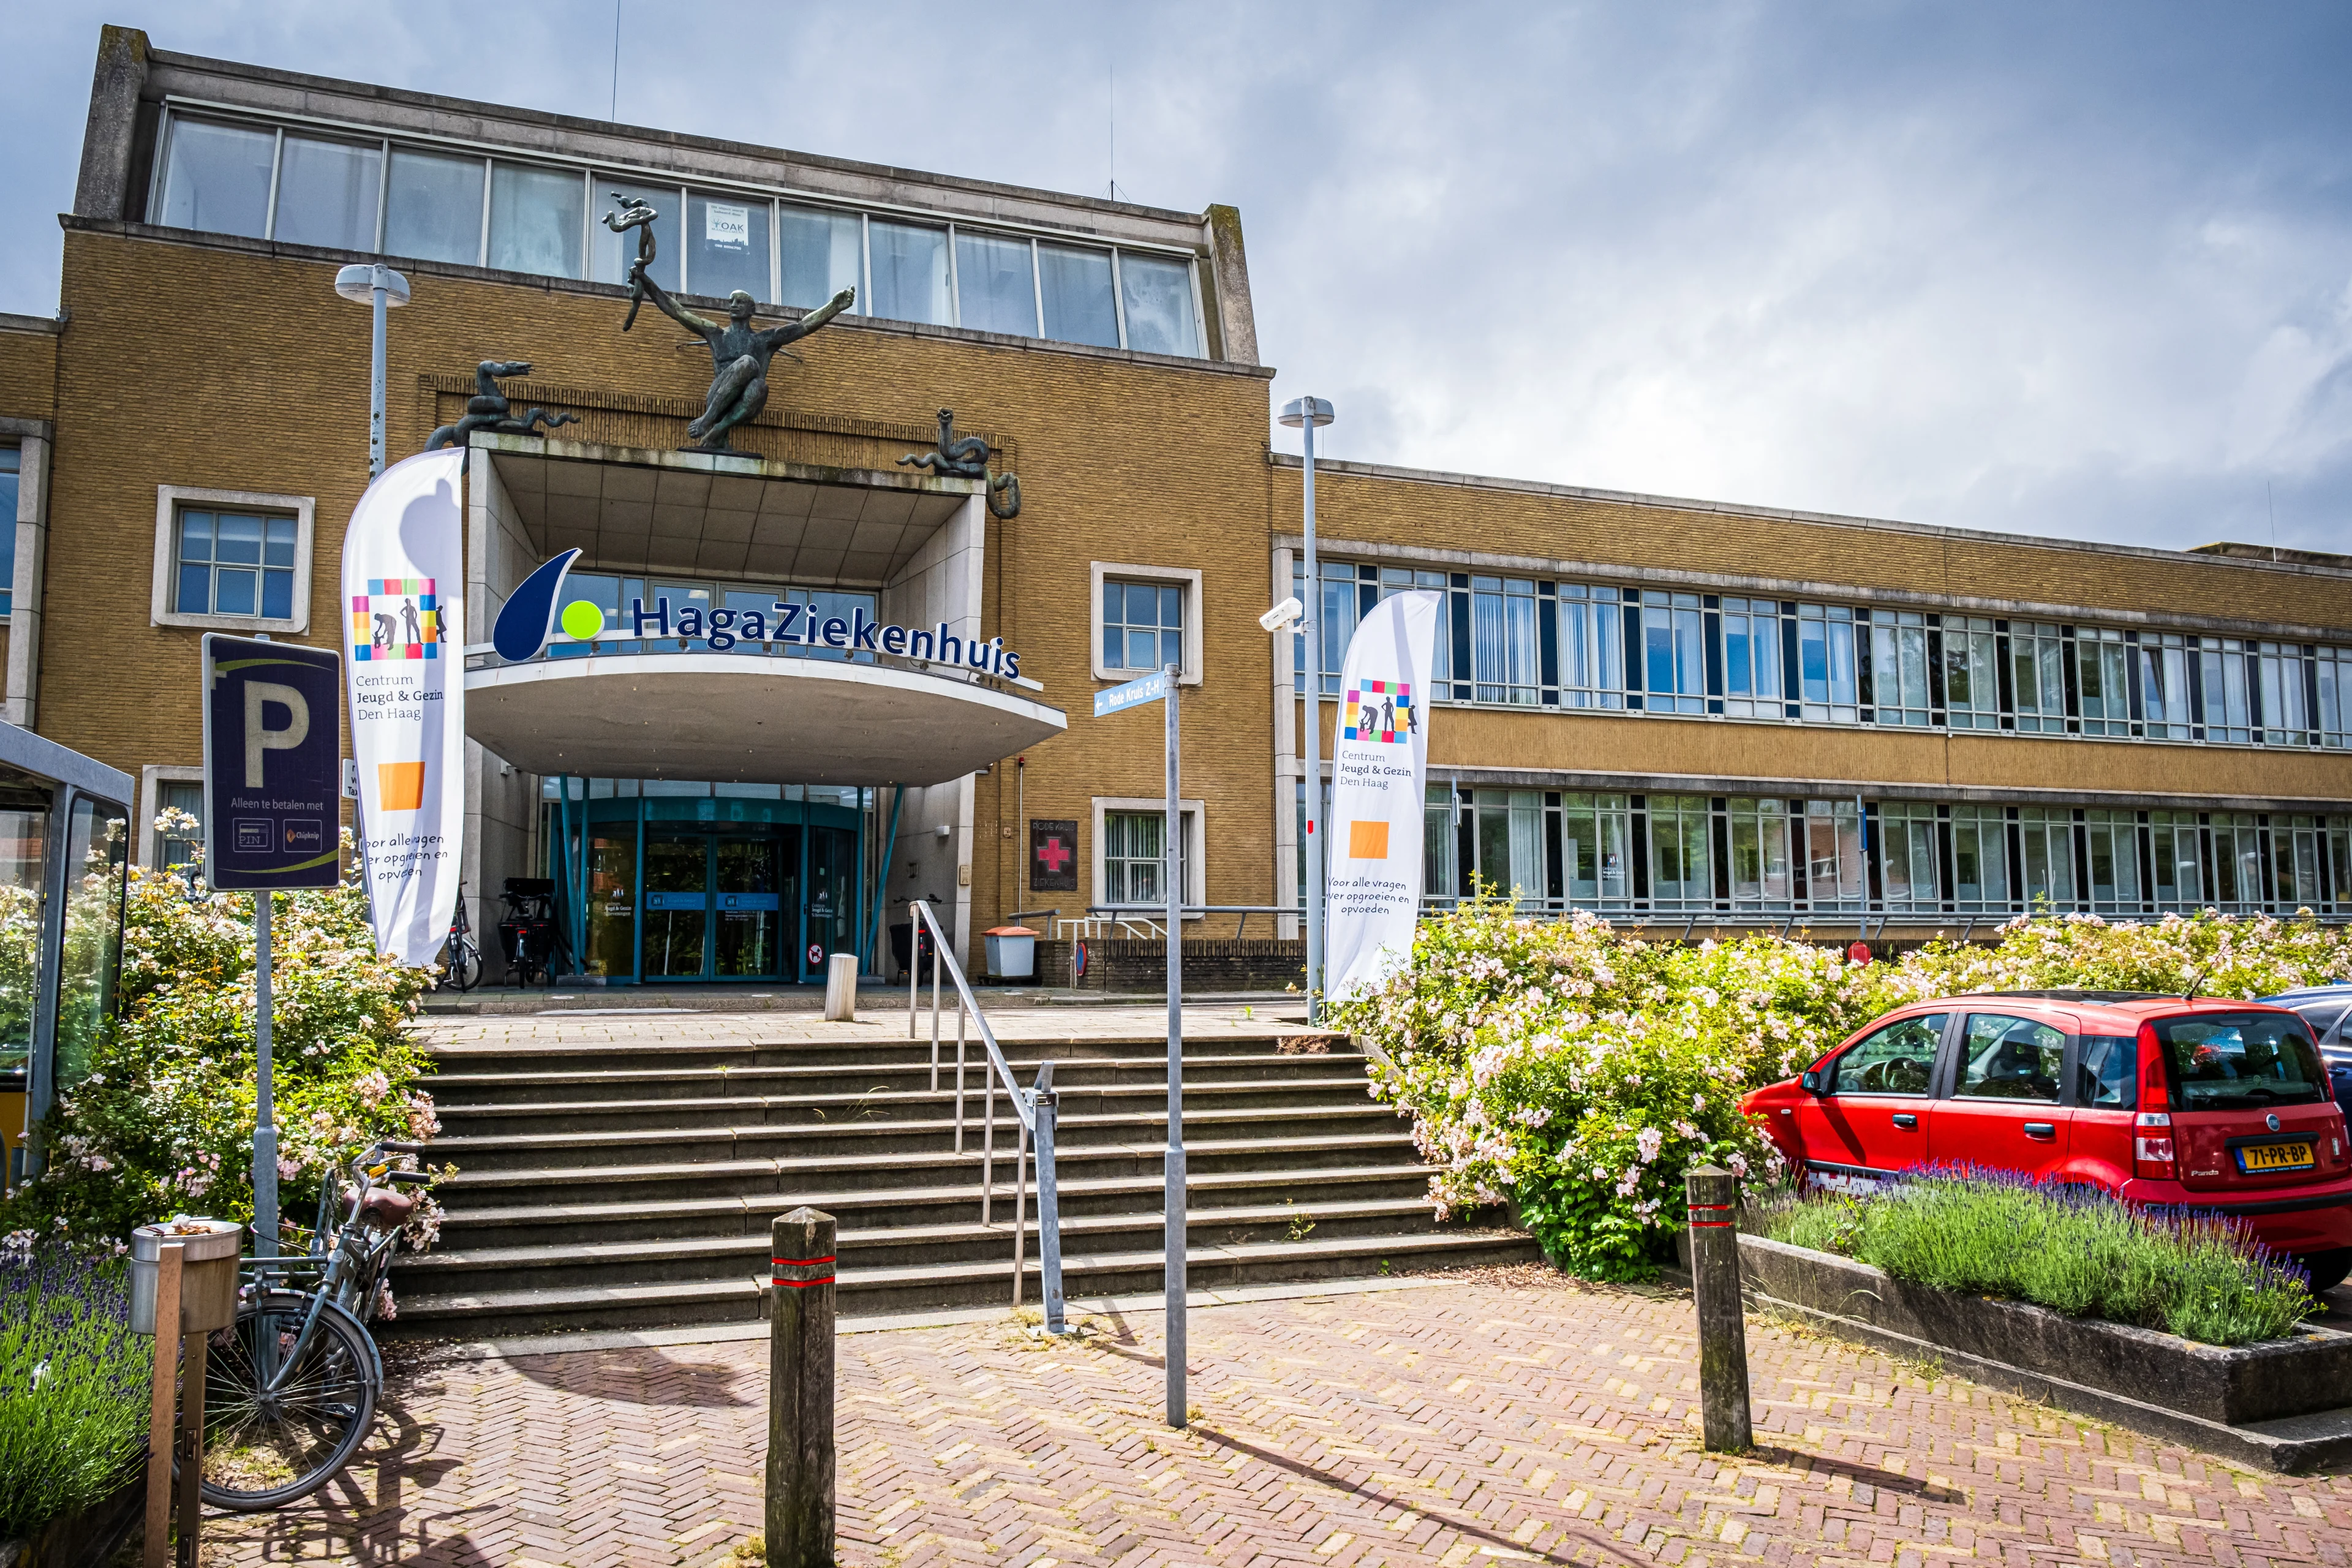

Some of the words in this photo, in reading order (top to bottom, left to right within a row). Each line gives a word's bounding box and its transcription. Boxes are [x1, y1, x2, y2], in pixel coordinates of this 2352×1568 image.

[721, 222, 744, 232] OAK
[631, 597, 1022, 680] HagaZiekenhuis
[356, 676, 413, 687] Centrum
[356, 691, 394, 705] Jeugd
[398, 690, 409, 701] &
[413, 689, 443, 701] Gezin
[1109, 692, 1125, 708] Rode
[1126, 685, 1144, 702] Kruis
[1145, 679, 1159, 697] Z-H
[358, 709, 383, 720] Den
[387, 708, 421, 721] Haag
[244, 680, 309, 788] P
[1342, 750, 1385, 762] Centrum
[1341, 763, 1370, 775] Jeugd
[1372, 765, 1381, 774] &
[1383, 767, 1412, 777] Gezin
[1340, 776, 1360, 786] Den
[1362, 778, 1389, 790] Haag
[231, 797, 259, 809] Alleen
[262, 799, 271, 809] te
[273, 799, 305, 810] betalen
[307, 802, 323, 810] met
[1055, 823, 1075, 831] KRUIS
[238, 835, 260, 844] PIN
[296, 831, 319, 840] Chipknip
[390, 833, 410, 846] alle
[411, 835, 444, 848] vragen
[368, 856, 380, 865] er
[1033, 877, 1075, 888] ZIEKENHUIS
[1327, 876, 1350, 886] Voor
[1352, 876, 1370, 887] alle
[1373, 880, 1406, 892] vragen
[1347, 892, 1396, 904] opgroeien
[1341, 903, 1389, 916] opvoeden
[2249, 1145, 2307, 1166] 71-PR-BP
